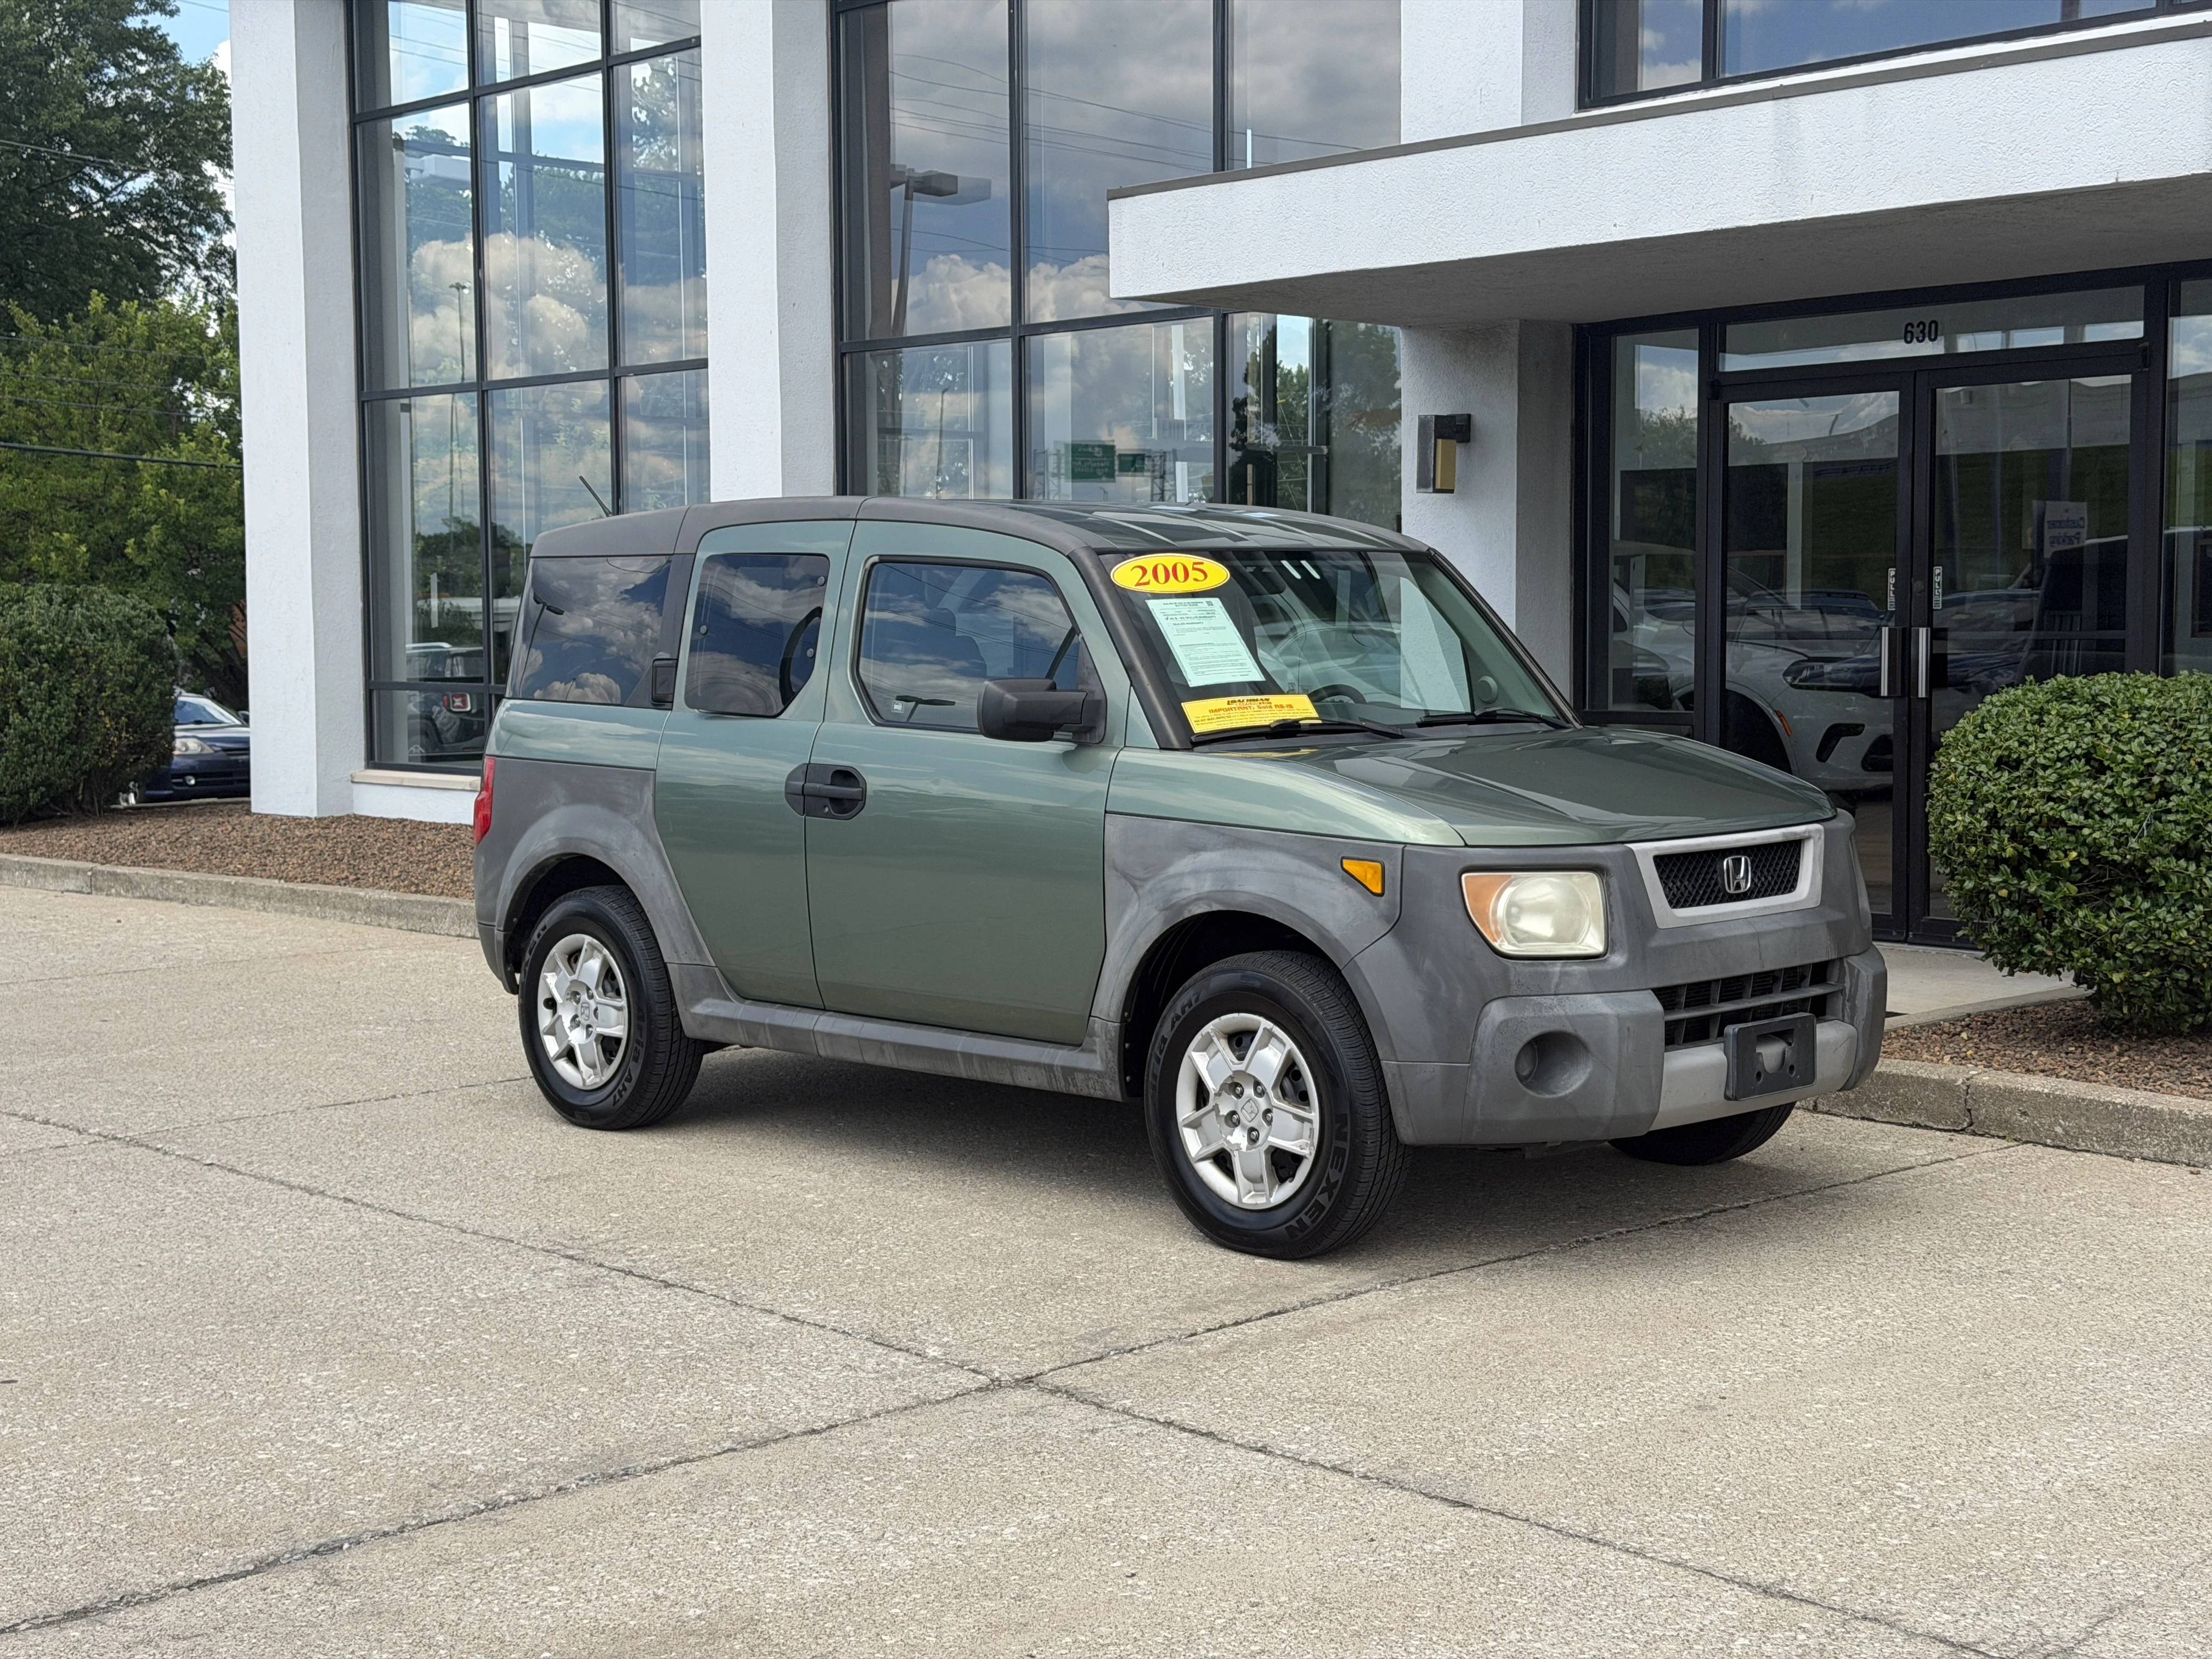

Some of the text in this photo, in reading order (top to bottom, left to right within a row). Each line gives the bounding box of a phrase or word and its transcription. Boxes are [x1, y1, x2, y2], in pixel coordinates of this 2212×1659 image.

[1903, 319, 1939, 344] 630
[1131, 561, 1208, 586] 2005
[1285, 1113, 1348, 1239] NEXEN
